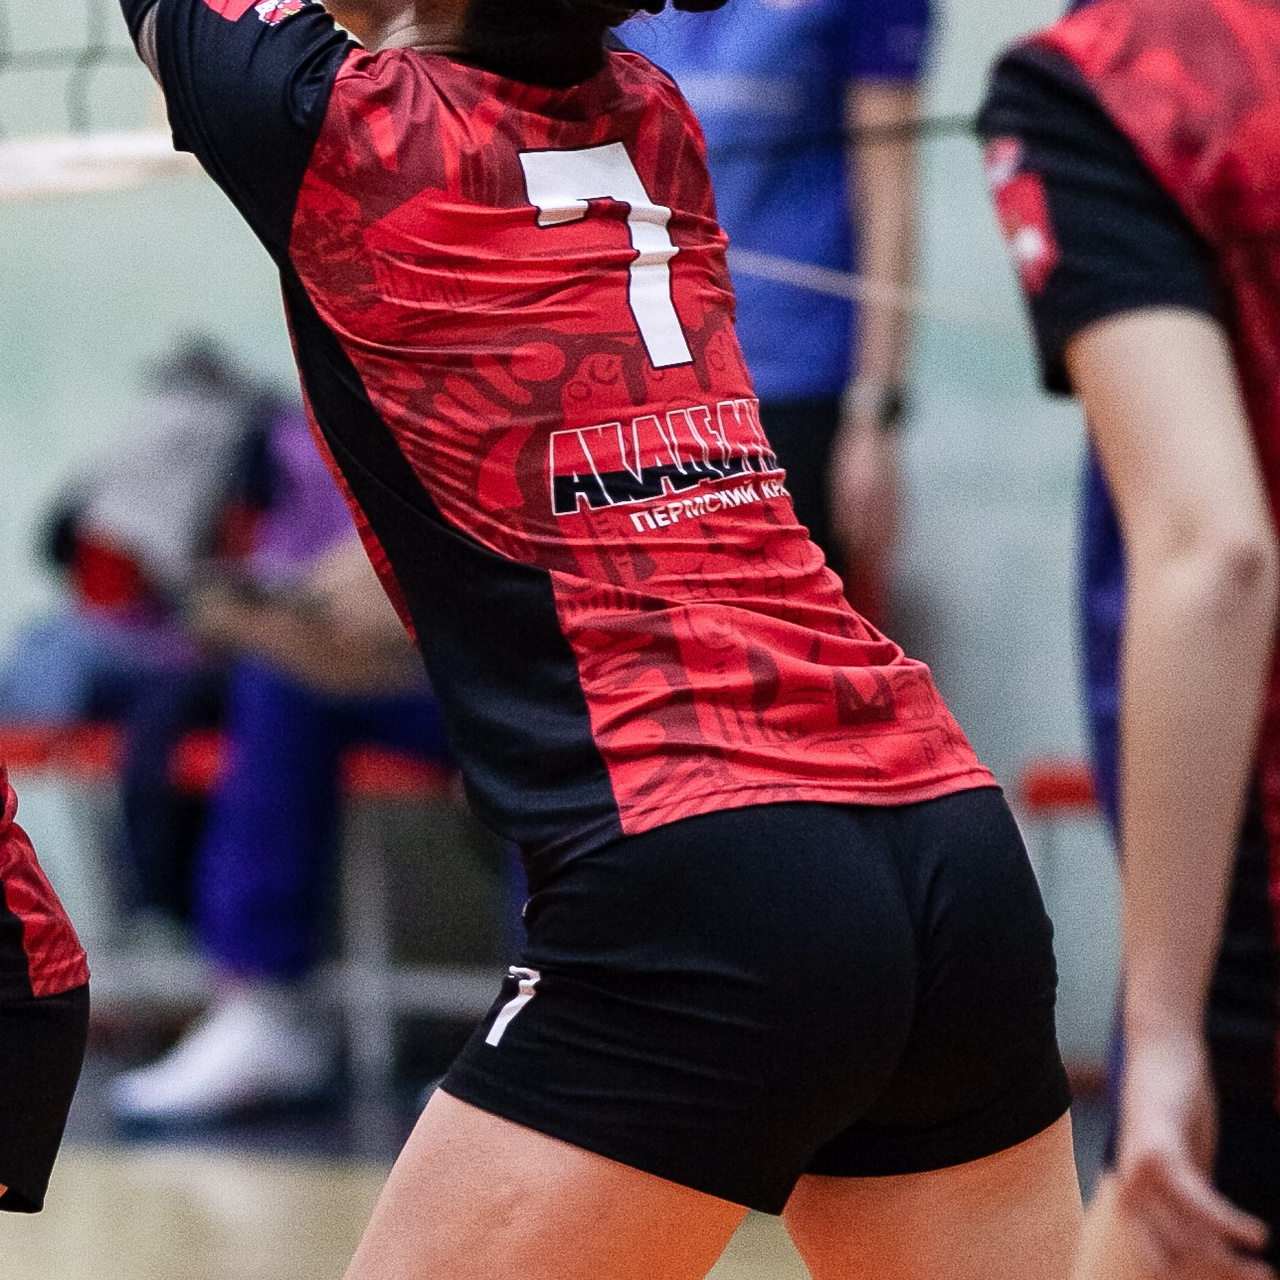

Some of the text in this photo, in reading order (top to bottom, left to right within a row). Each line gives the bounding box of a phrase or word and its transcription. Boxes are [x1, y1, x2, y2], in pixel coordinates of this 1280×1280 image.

[519, 141, 695, 370] 7
[629, 479, 762, 533] ПЕРМСКИЙ
[485, 965, 541, 1048] 7
